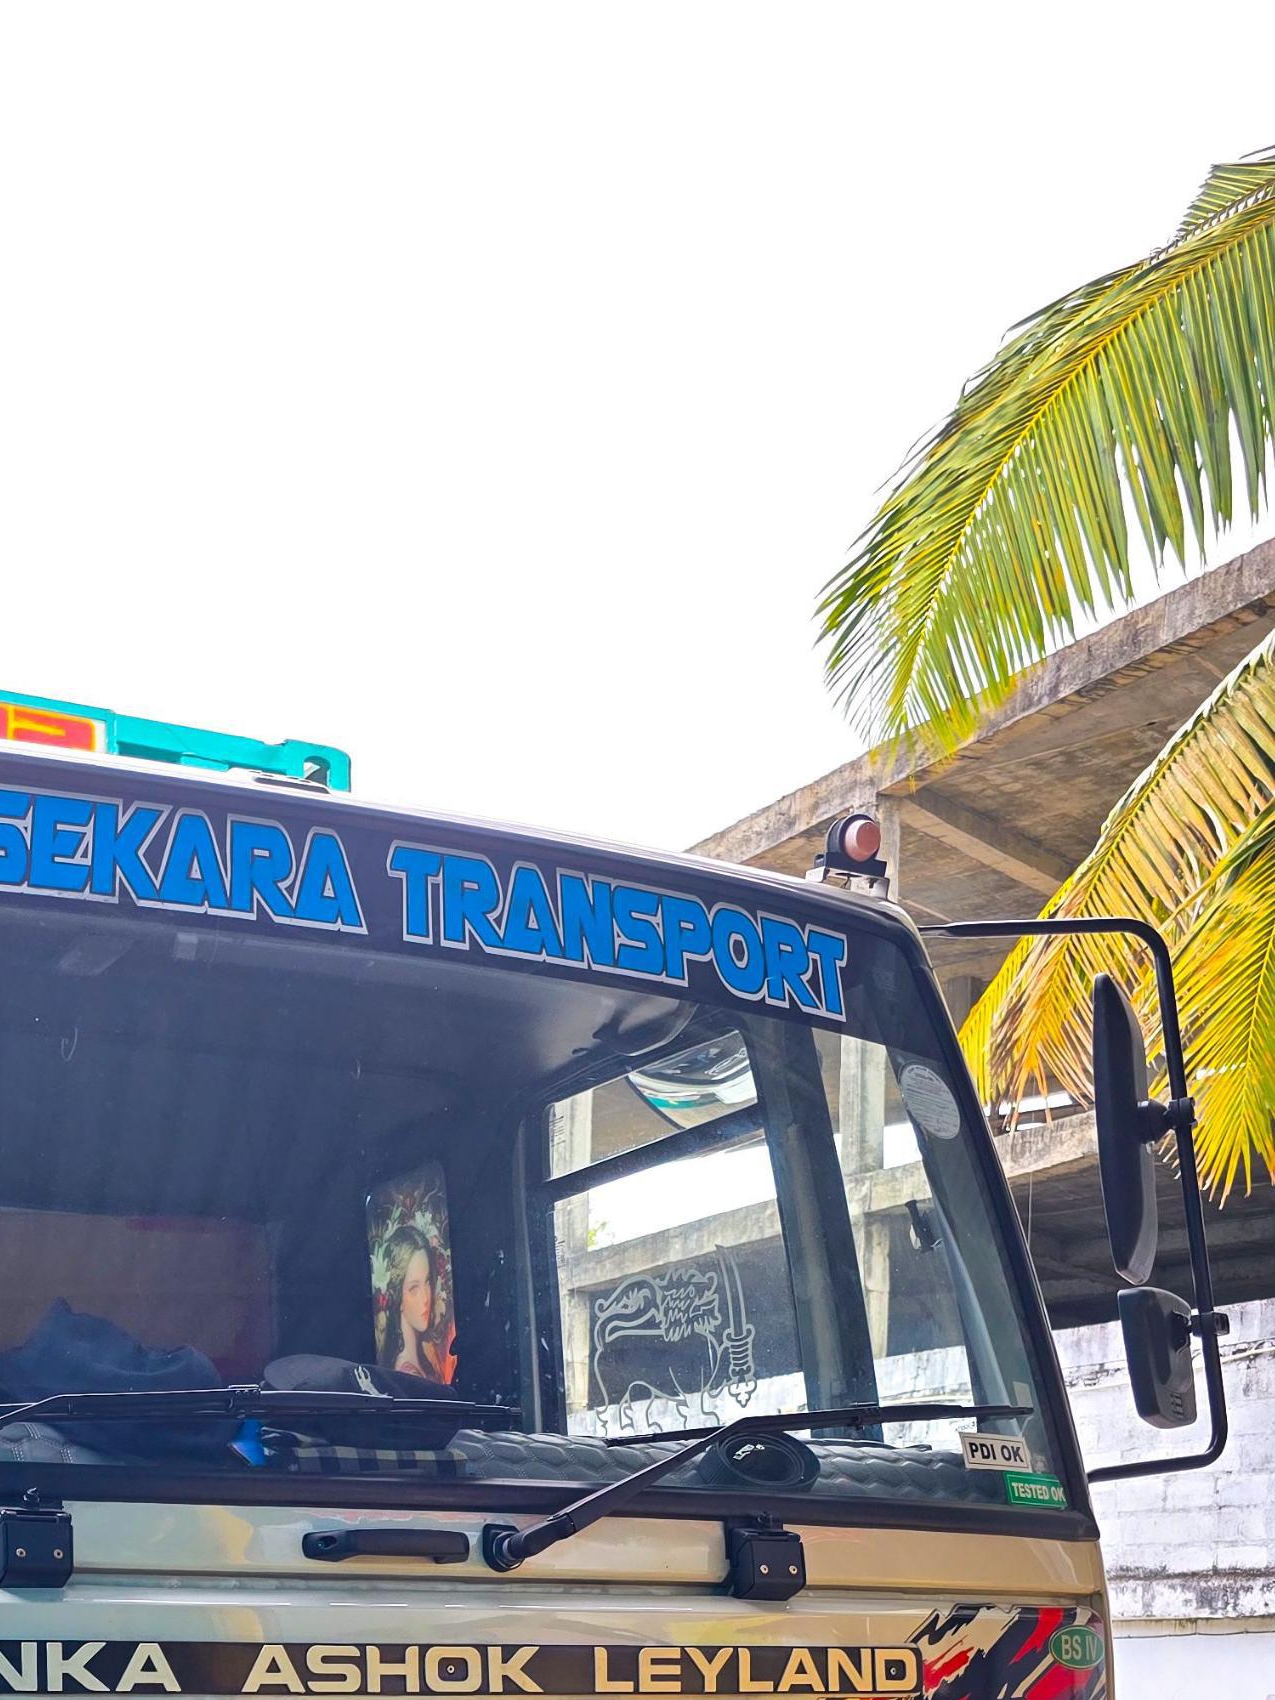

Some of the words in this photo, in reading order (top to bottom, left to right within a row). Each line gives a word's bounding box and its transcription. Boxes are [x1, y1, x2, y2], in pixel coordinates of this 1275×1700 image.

[386, 839, 848, 1023] TRANSPORT
[968, 1442, 997, 1460] PDI
[1000, 1445, 1024, 1463] OK
[1012, 1482, 1050, 1500] TESTED
[1050, 1486, 1066, 1502] OK
[1061, 1634, 1082, 1661] BS
[240, 1644, 544, 1694] ASHOK
[593, 1645, 920, 1693] LEYLAND
